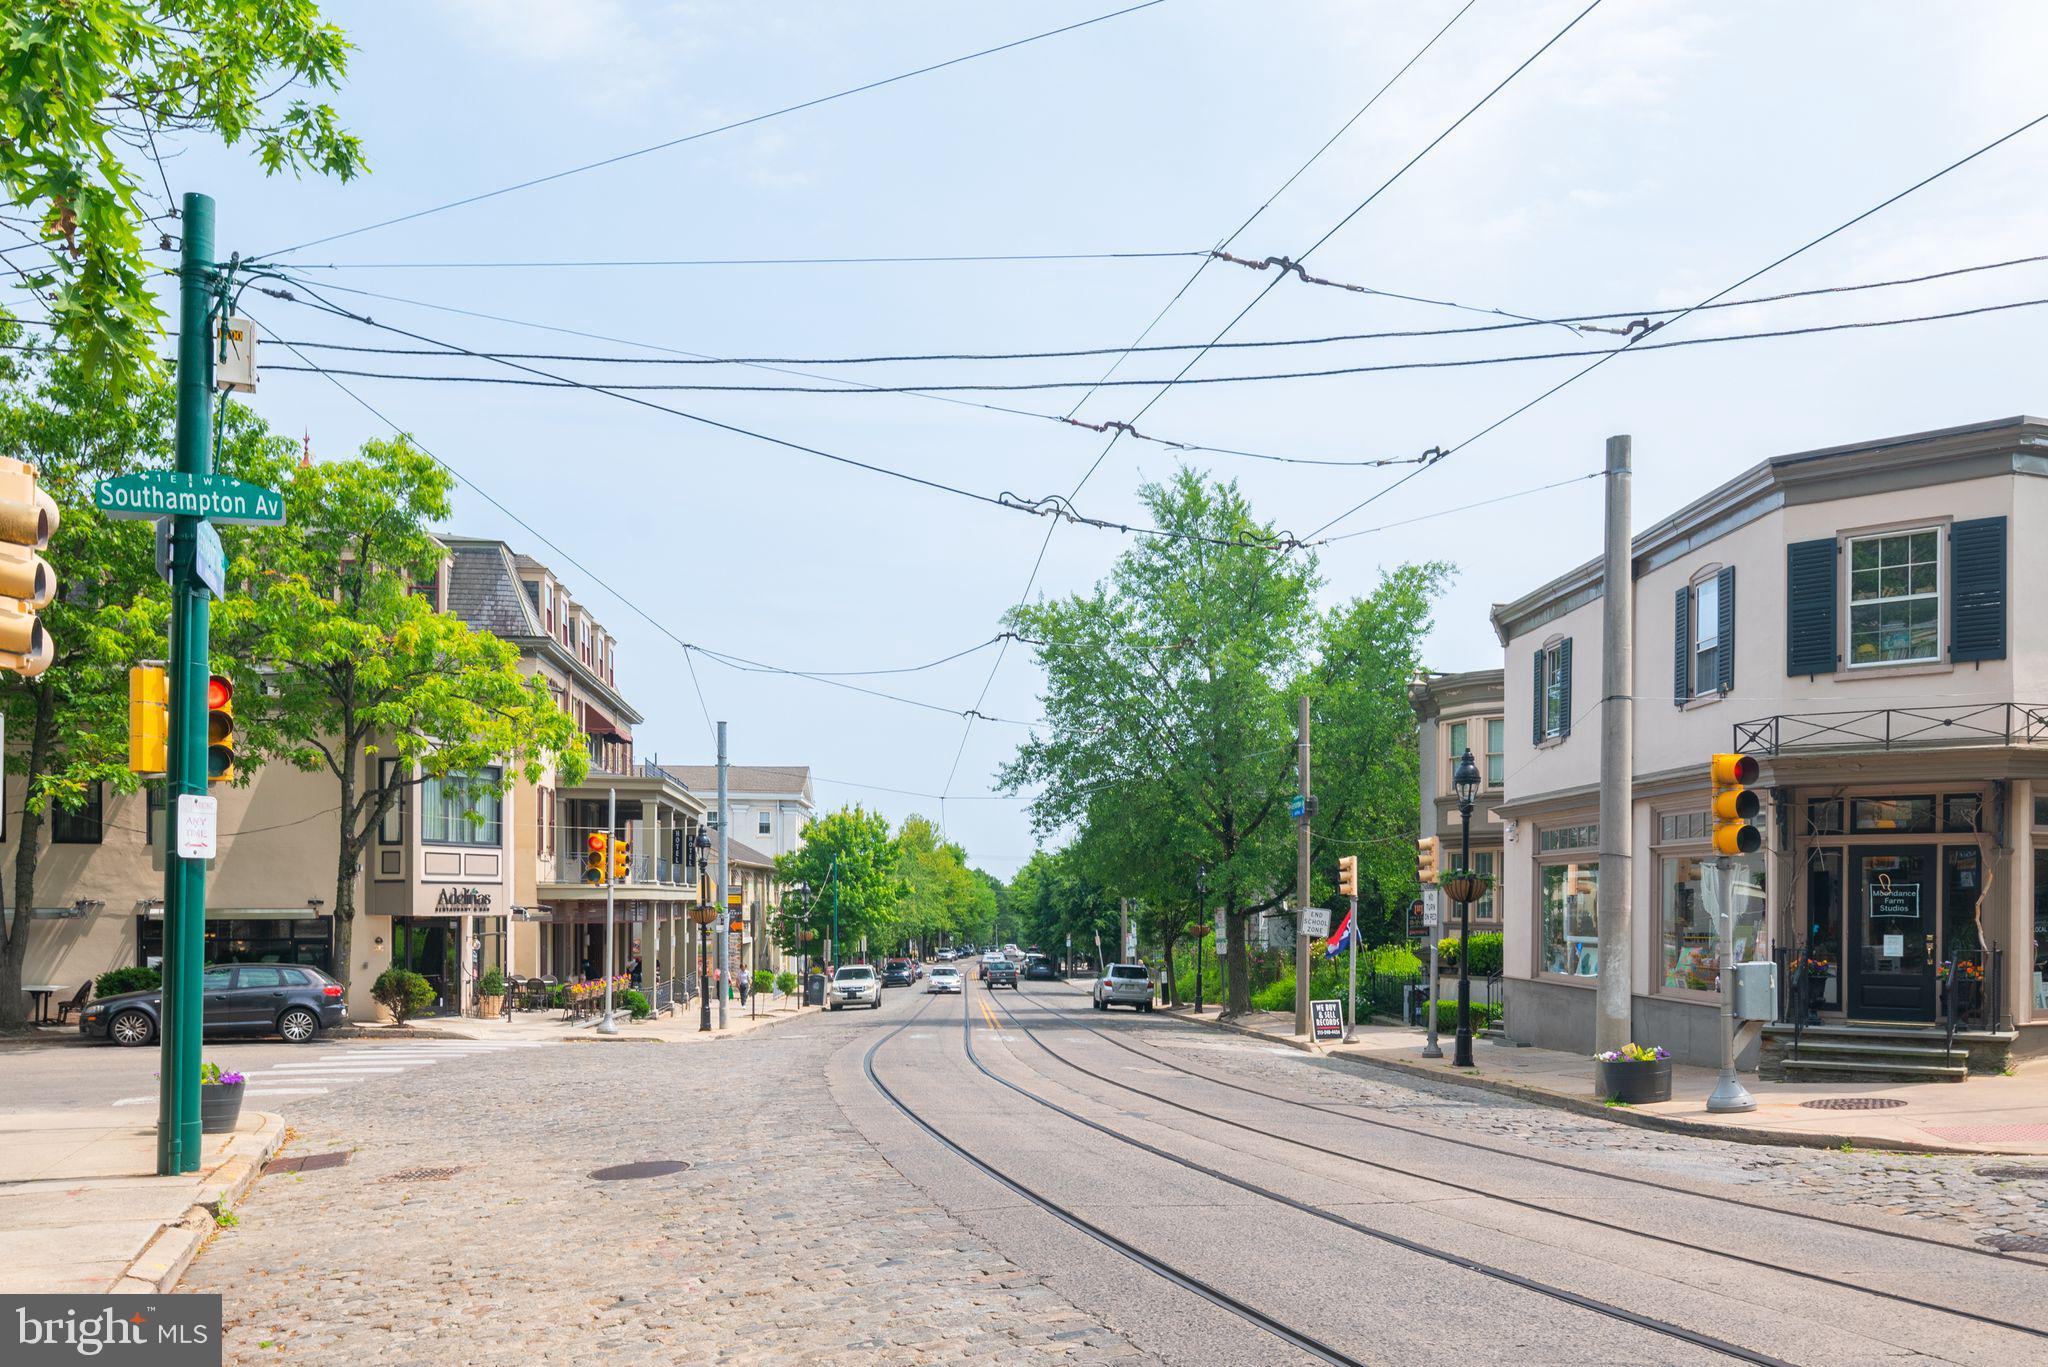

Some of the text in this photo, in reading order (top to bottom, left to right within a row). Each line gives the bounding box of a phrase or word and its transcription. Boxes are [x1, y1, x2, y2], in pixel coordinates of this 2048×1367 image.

[170, 475, 177, 484] E
[203, 478, 213, 486] W
[100, 482, 279, 516] Southampton Av
[1310, 911, 1323, 919] END
[1304, 918, 1328, 927] SCHOOL
[1306, 924, 1323, 934] ZONE
[1325, 1003, 1336, 1011] BUY
[1316, 1018, 1340, 1026] RECORDS
